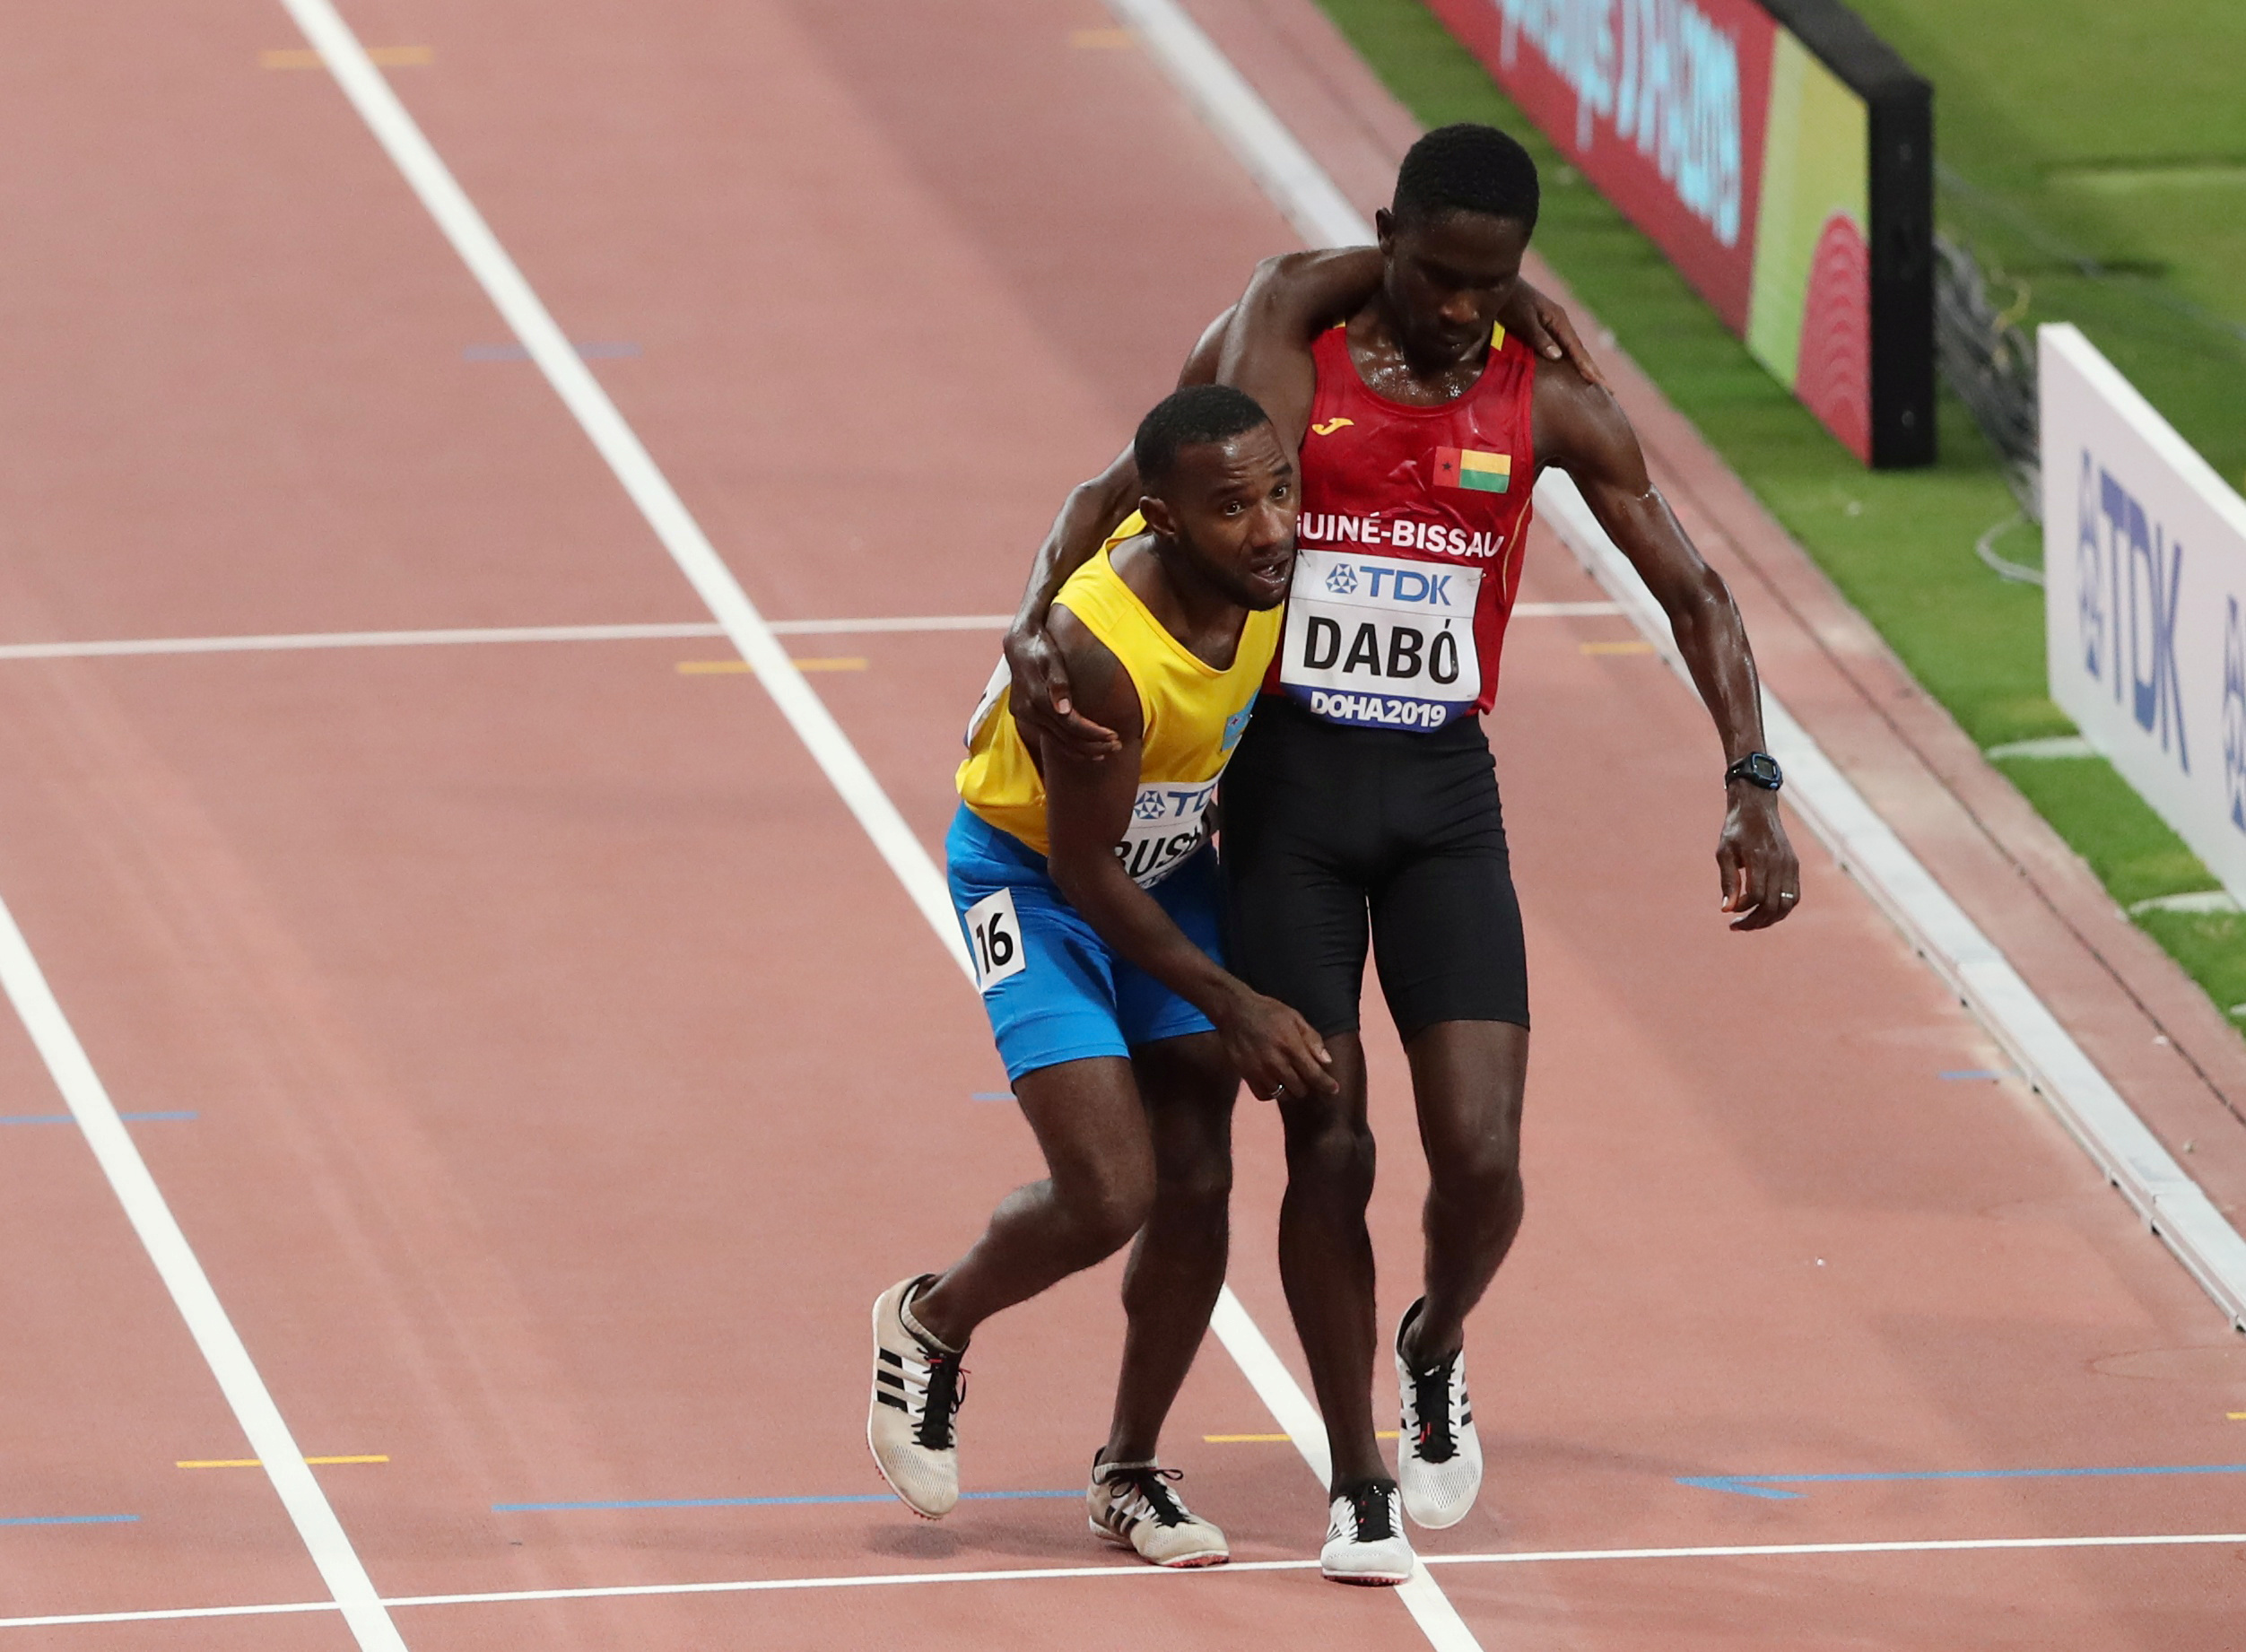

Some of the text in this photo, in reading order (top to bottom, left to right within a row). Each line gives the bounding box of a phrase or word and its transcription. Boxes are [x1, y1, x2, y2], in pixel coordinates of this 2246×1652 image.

[1296, 512, 1504, 558] UINÉ-BISSAU
[1360, 566, 1451, 606] TDK
[2101, 468, 2189, 773] TDK
[1303, 616, 1459, 685] DABÓ
[1311, 691, 1446, 727] DOHA2019
[976, 913, 1014, 974] 16
